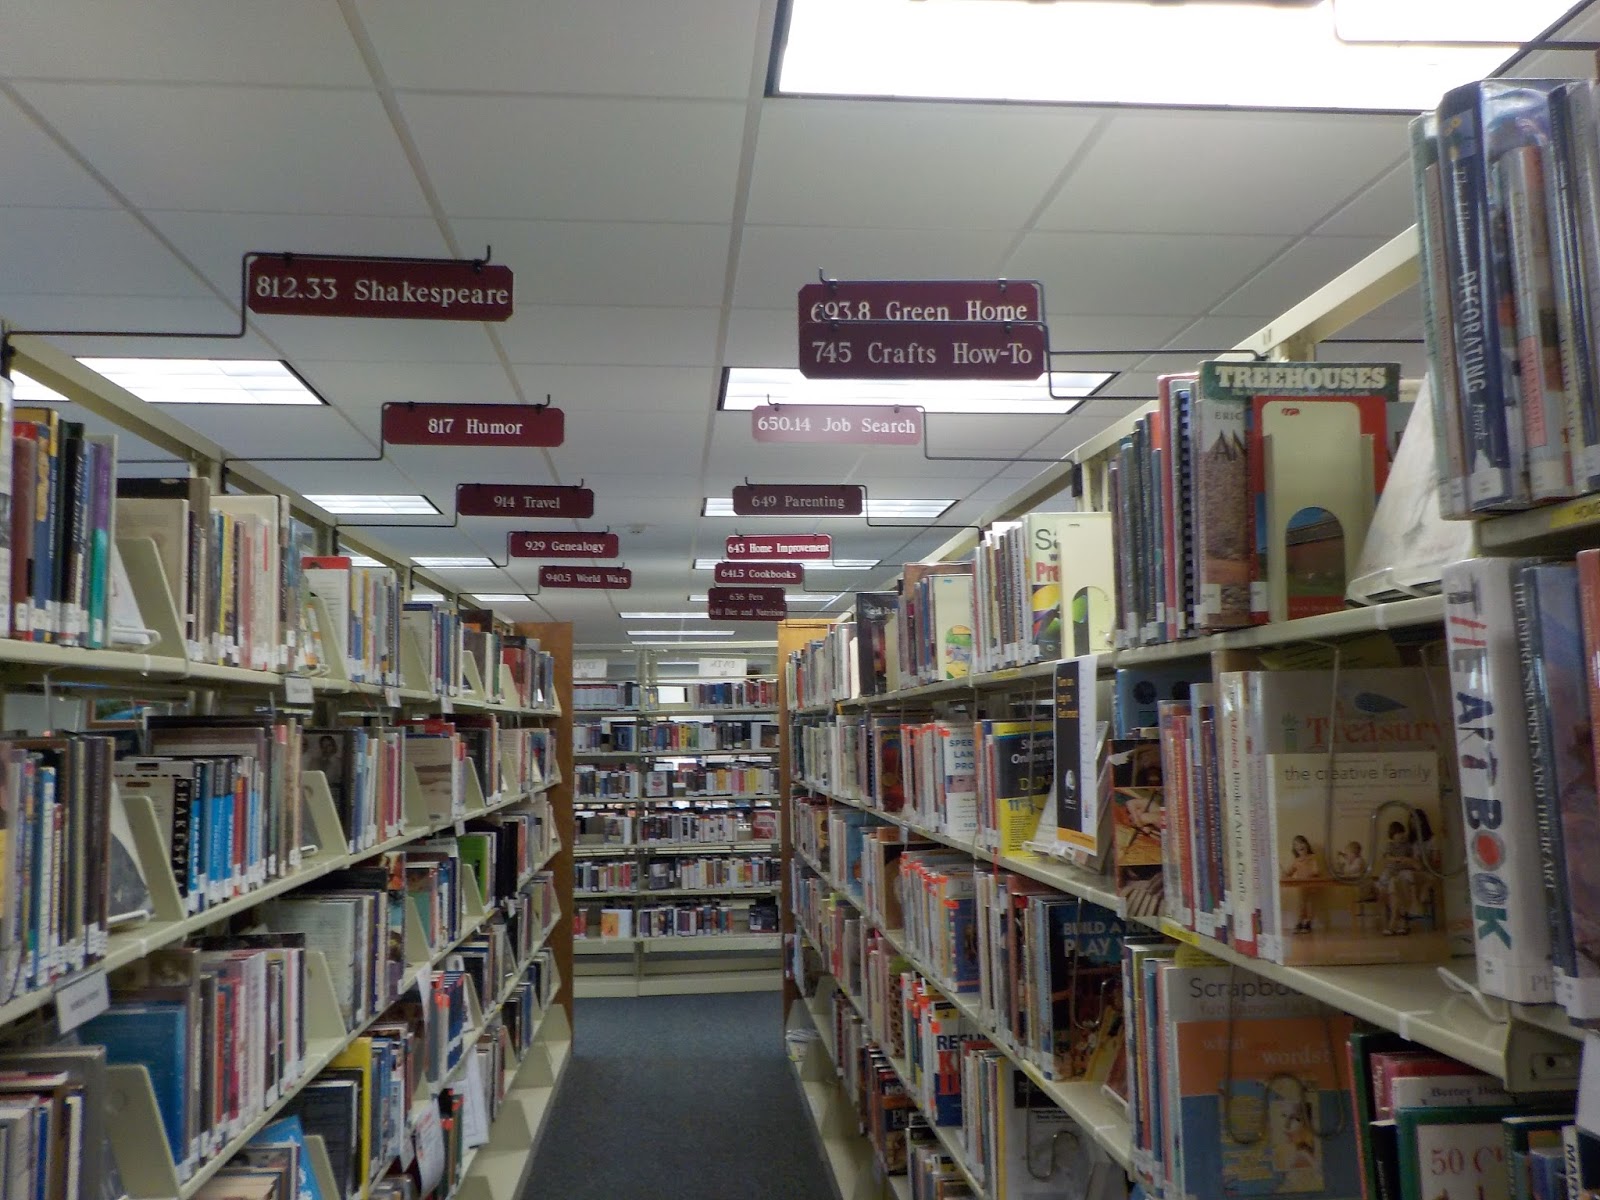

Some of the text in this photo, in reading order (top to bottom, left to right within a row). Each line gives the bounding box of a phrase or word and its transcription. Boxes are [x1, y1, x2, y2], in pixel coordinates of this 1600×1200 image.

[256, 276, 509, 308] 812.33 Shakespeare
[810, 300, 1028, 322] 693.8 Green Home
[1458, 270, 1486, 393] DECORATING
[812, 341, 1033, 364] 745 Crafts How-To
[1215, 366, 1387, 390] TREEHOUSES
[756, 416, 916, 434] 650.14 Job Search
[1214, 411, 1243, 420] ERIC
[428, 418, 523, 435] 817 Humor
[494, 496, 560, 509] 914 Travel
[751, 495, 846, 509] 649 Parenting
[525, 541, 605, 553] 929 Genealogy
[749, 543, 773, 553] Home
[776, 543, 829, 554] Improvement
[545, 573, 628, 583] 940.5 World Wars
[749, 569, 797, 579] Cookbooks
[1456, 691, 1499, 788] ART
[1283, 762, 1432, 782] the creative family
[1235, 820, 1245, 847] Arts
[1237, 861, 1247, 902] Crafts
[1464, 796, 1512, 951] BOOK
[1431, 1148, 1464, 1176] 50
